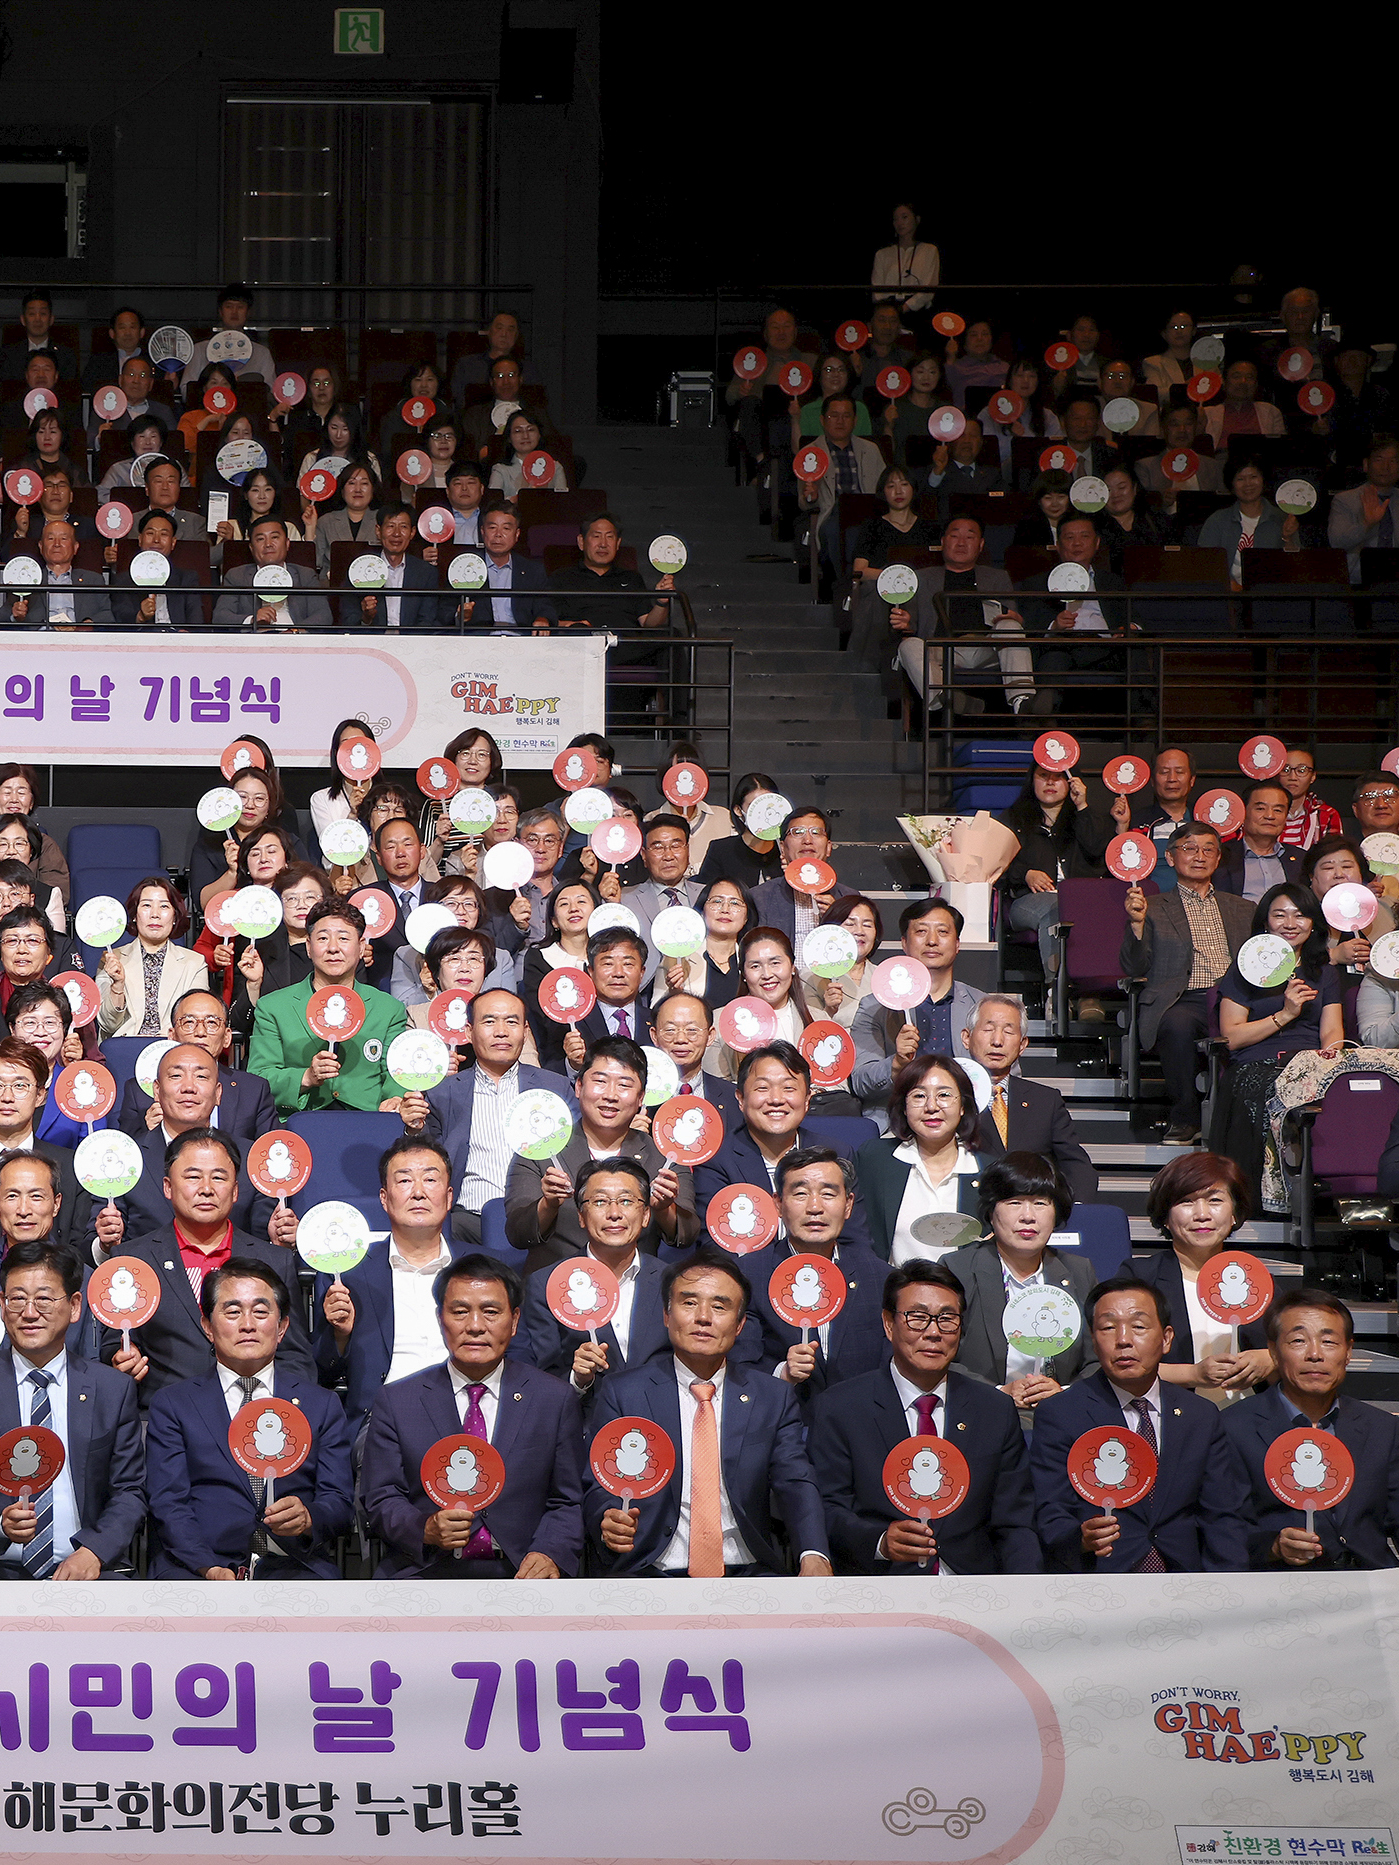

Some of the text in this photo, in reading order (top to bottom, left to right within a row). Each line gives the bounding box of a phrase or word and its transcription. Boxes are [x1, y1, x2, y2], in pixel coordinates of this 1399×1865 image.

[71, 675, 116, 722] 날
[140, 676, 282, 724] 기념식
[451, 680, 498, 699] GIM
[310, 1662, 402, 1753] 날
[453, 1660, 752, 1753] 기념식
[1151, 1687, 1188, 1704] DON'T
[1154, 1701, 1245, 1735] GIM
[1288, 1768, 1375, 1784] 행복도시 김해
[357, 1782, 522, 1838] 누리홀
[1223, 1834, 1283, 1857] 친환경
[1286, 1837, 1346, 1857] 현수막
